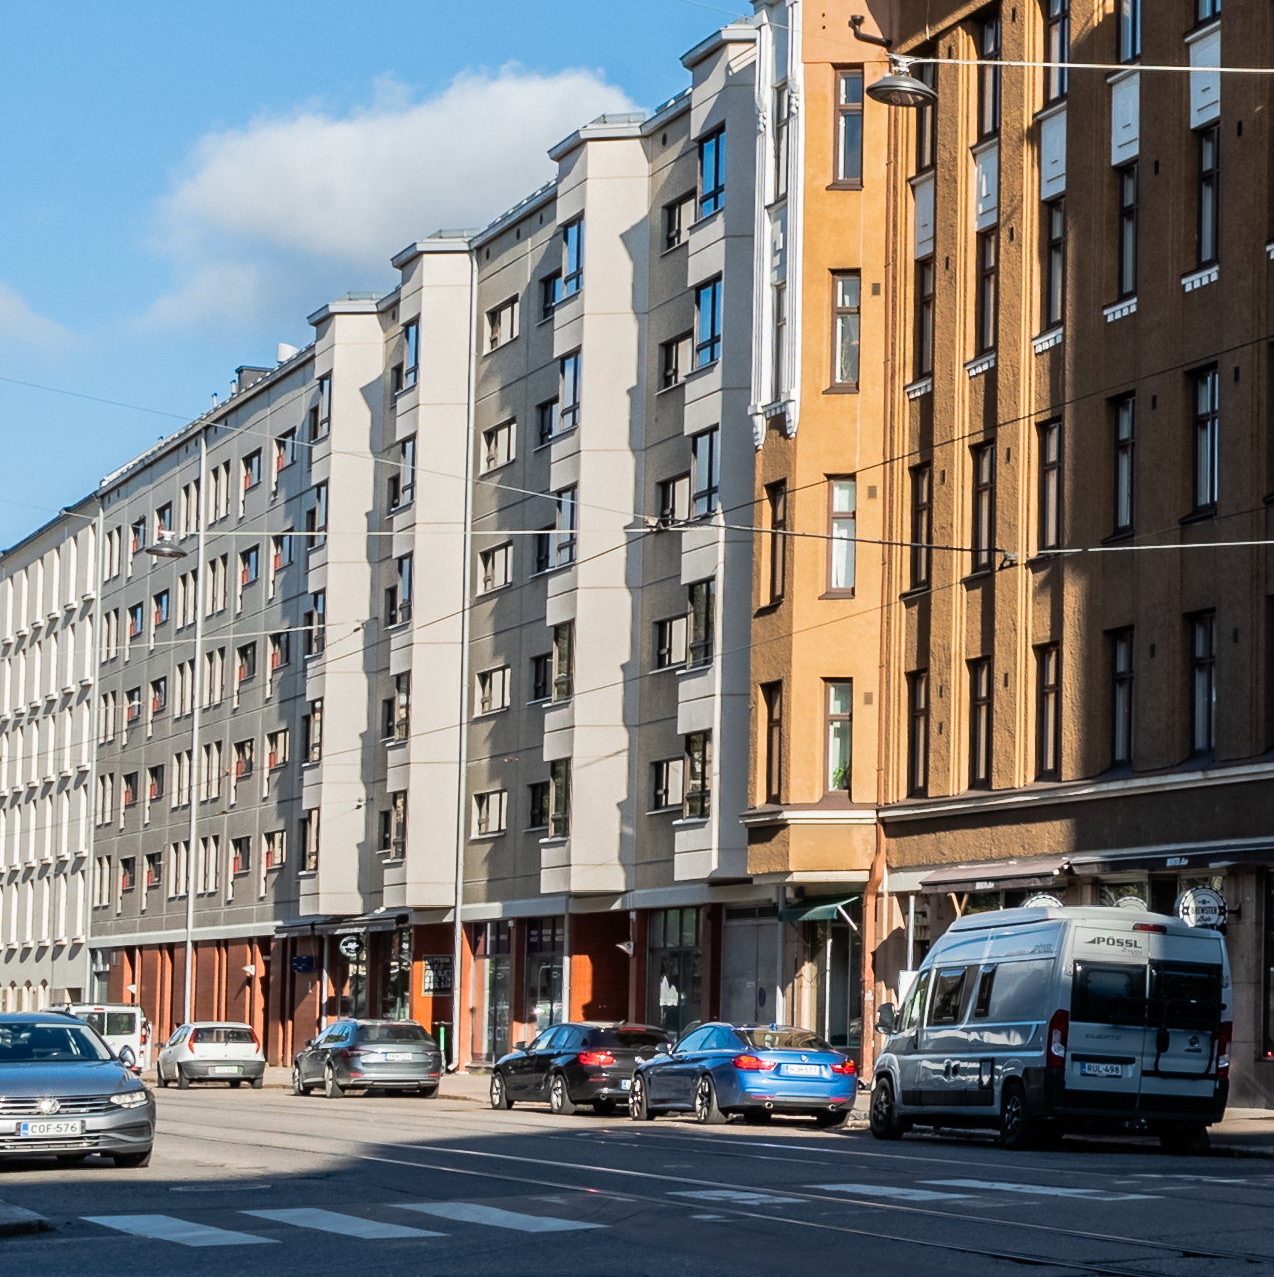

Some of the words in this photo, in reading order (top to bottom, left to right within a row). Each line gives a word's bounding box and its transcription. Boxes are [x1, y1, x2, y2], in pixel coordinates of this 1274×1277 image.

[1096, 935, 1143, 949] PÖSSL
[1087, 1064, 1120, 1075] RUL-498
[31, 1123, 77, 1134] COF-576
